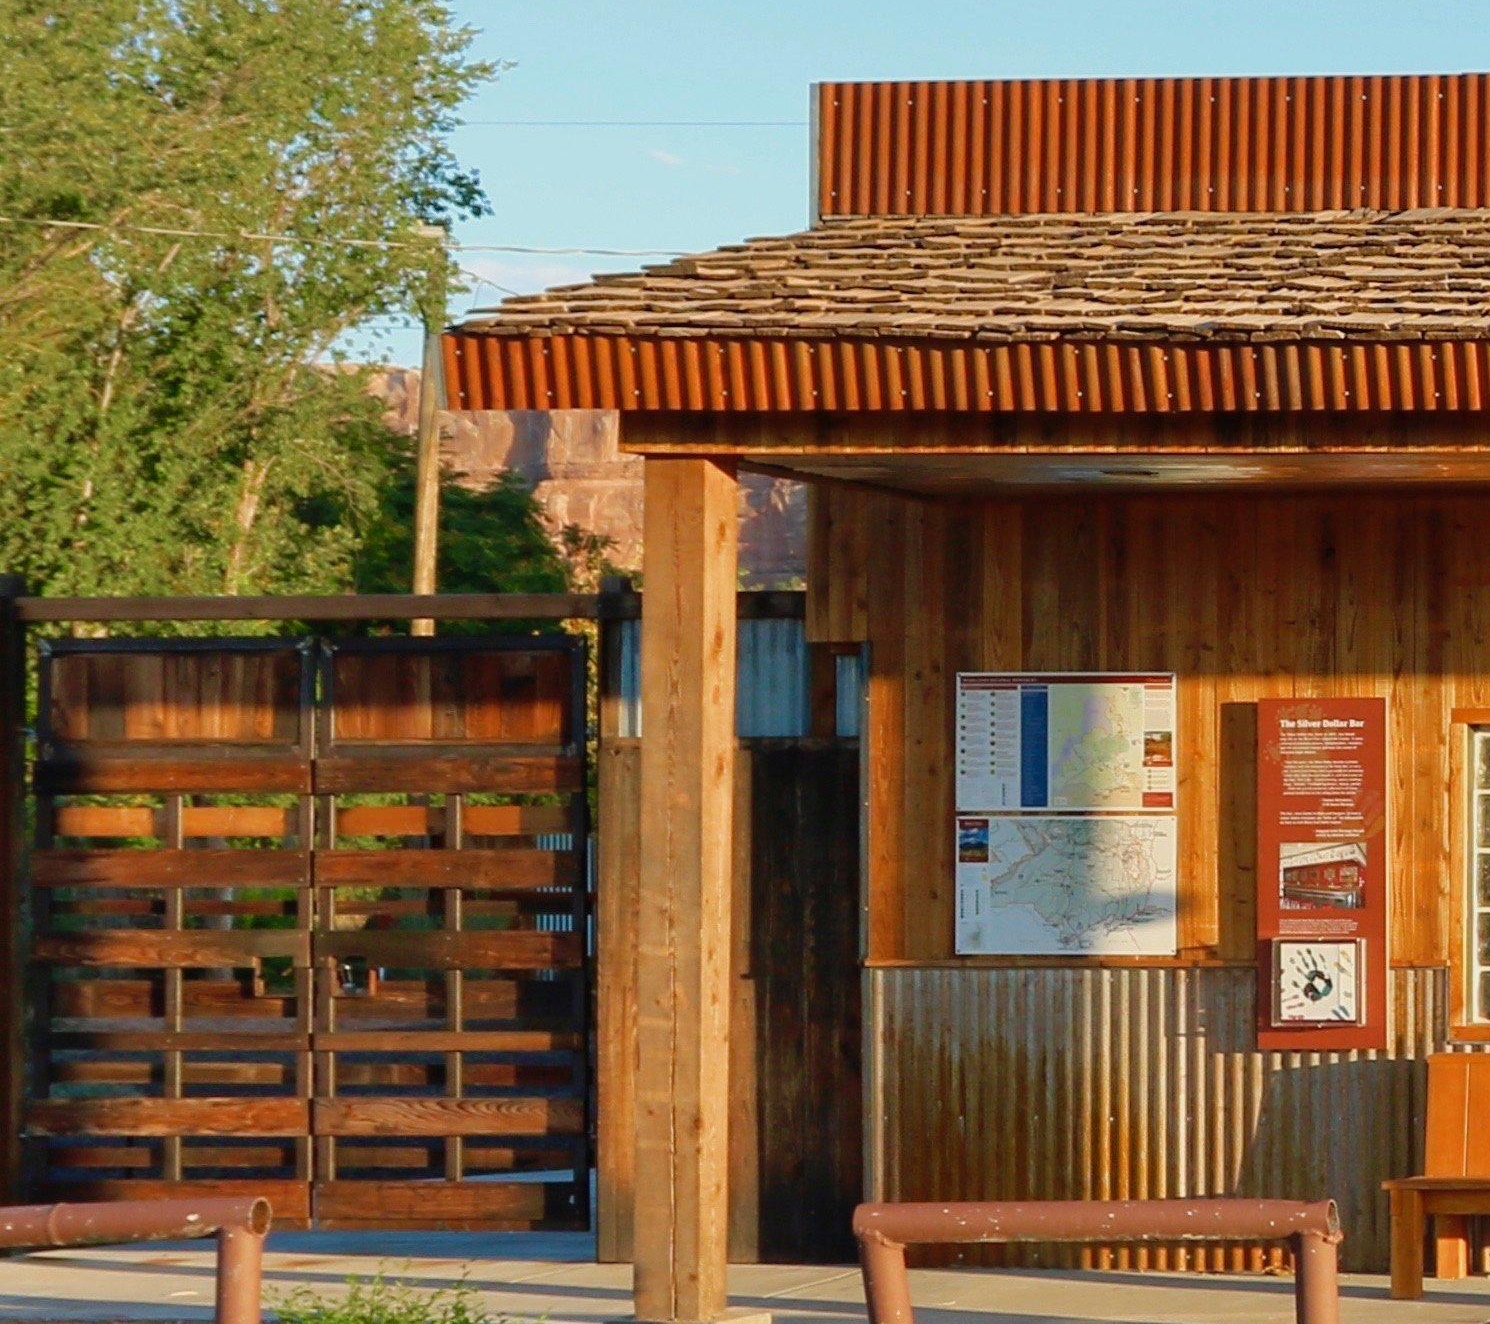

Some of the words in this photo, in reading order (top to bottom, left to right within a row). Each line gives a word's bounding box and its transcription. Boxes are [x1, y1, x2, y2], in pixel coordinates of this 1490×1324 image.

[1280, 719, 1295, 727] The
[1297, 719, 1321, 727] Silver
[1323, 719, 1347, 727] Dollar
[1349, 719, 1364, 727] Bar
